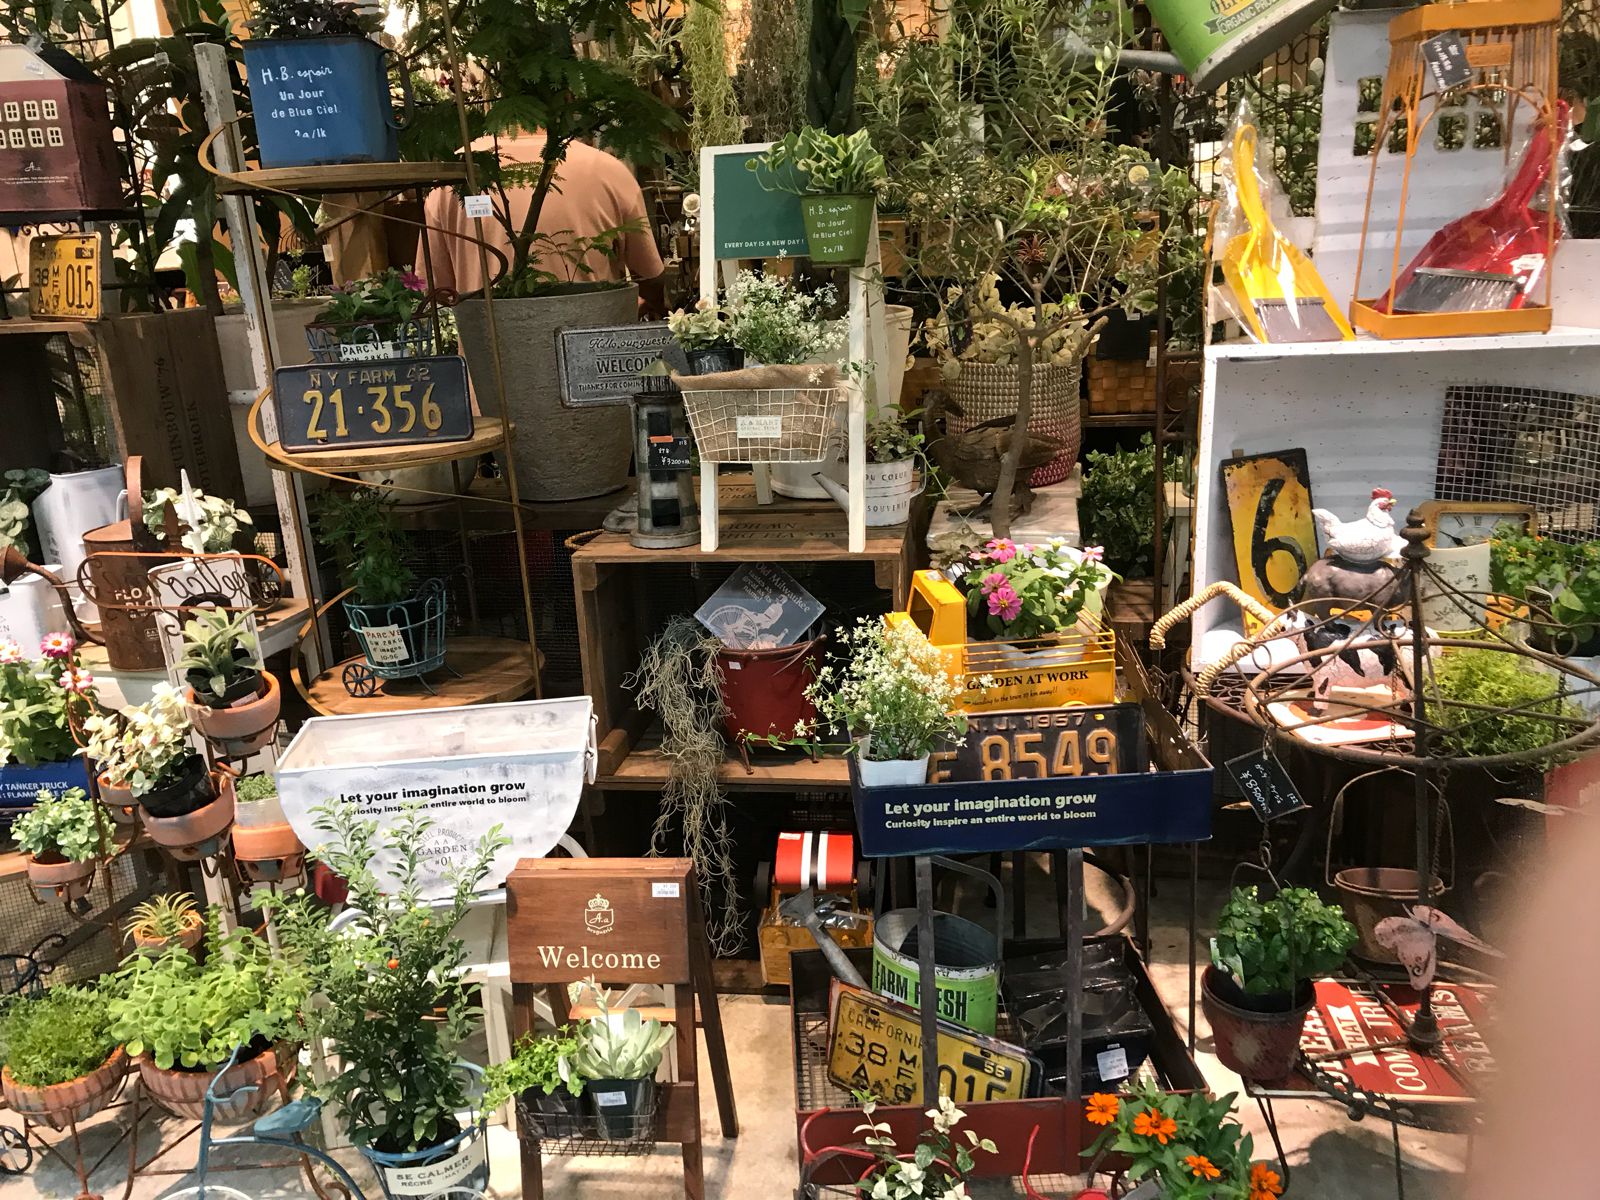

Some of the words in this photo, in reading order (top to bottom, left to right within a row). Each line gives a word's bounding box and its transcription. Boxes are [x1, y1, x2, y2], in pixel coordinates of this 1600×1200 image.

[298, 89, 325, 99] Jour
[271, 108, 286, 119] de
[288, 107, 313, 118] Blue
[316, 104, 338, 115] Ciel
[724, 241, 744, 249] EVERY
[787, 238, 800, 246] DAY
[820, 231, 836, 239] Blue
[65, 263, 94, 309] 015
[595, 356, 658, 374] WELCOM
[349, 369, 397, 385] FARM
[1252, 478, 1307, 609] 6
[966, 675, 1023, 691] GADEN
[1026, 673, 1045, 685] AT
[1046, 670, 1089, 683] WORK
[1024, 711, 1087, 729] 1957
[5, 782, 40, 791] TANKER
[40, 781, 69, 790] TRUCK
[7, 790, 60, 799] FLAMMLE
[340, 793, 362, 804] Let
[365, 790, 398, 805] your
[402, 783, 486, 800] imagination
[490, 781, 526, 794] grow
[430, 799, 457, 809] entire
[459, 798, 485, 807] world
[486, 797, 497, 806] to
[498, 795, 527, 803] bloom
[885, 801, 910, 815] Let
[913, 801, 950, 817] your
[954, 794, 1051, 813] imagination
[1055, 793, 1097, 809] grow
[885, 817, 931, 829] Curiosity
[933, 815, 969, 828] inspire
[970, 816, 983, 824] an
[984, 813, 1016, 824] entire
[1017, 811, 1048, 822] world
[1049, 811, 1061, 820] to
[1063, 809, 1097, 819] bloom
[416, 844, 468, 856] GARDEN
[536, 945, 662, 969] Welcome
[874, 959, 909, 1001] FARM
[845, 1031, 889, 1068] 38
